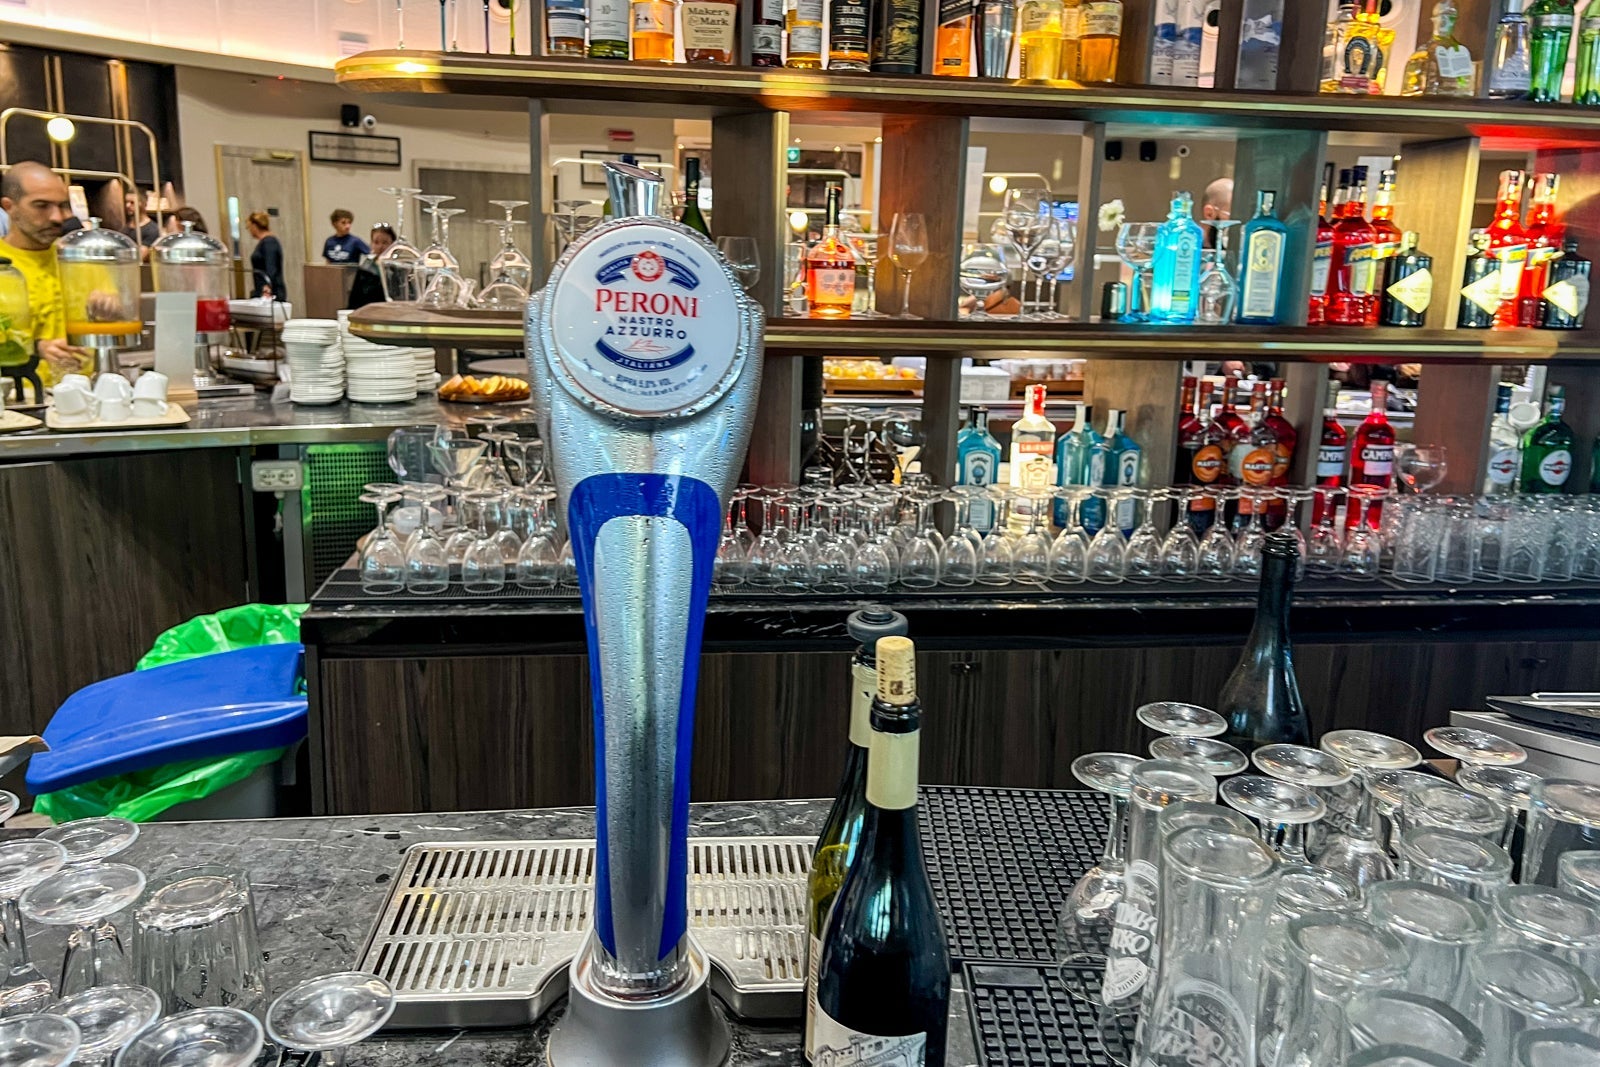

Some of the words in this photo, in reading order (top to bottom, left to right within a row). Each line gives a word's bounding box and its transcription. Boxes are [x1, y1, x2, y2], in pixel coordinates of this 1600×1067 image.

[687, 7, 730, 17] Maker's
[700, 17, 729, 26] Mark
[595, 288, 699, 318] PERONI
[618, 316, 674, 327] NASTRO
[604, 326, 687, 340] AZZURRO
